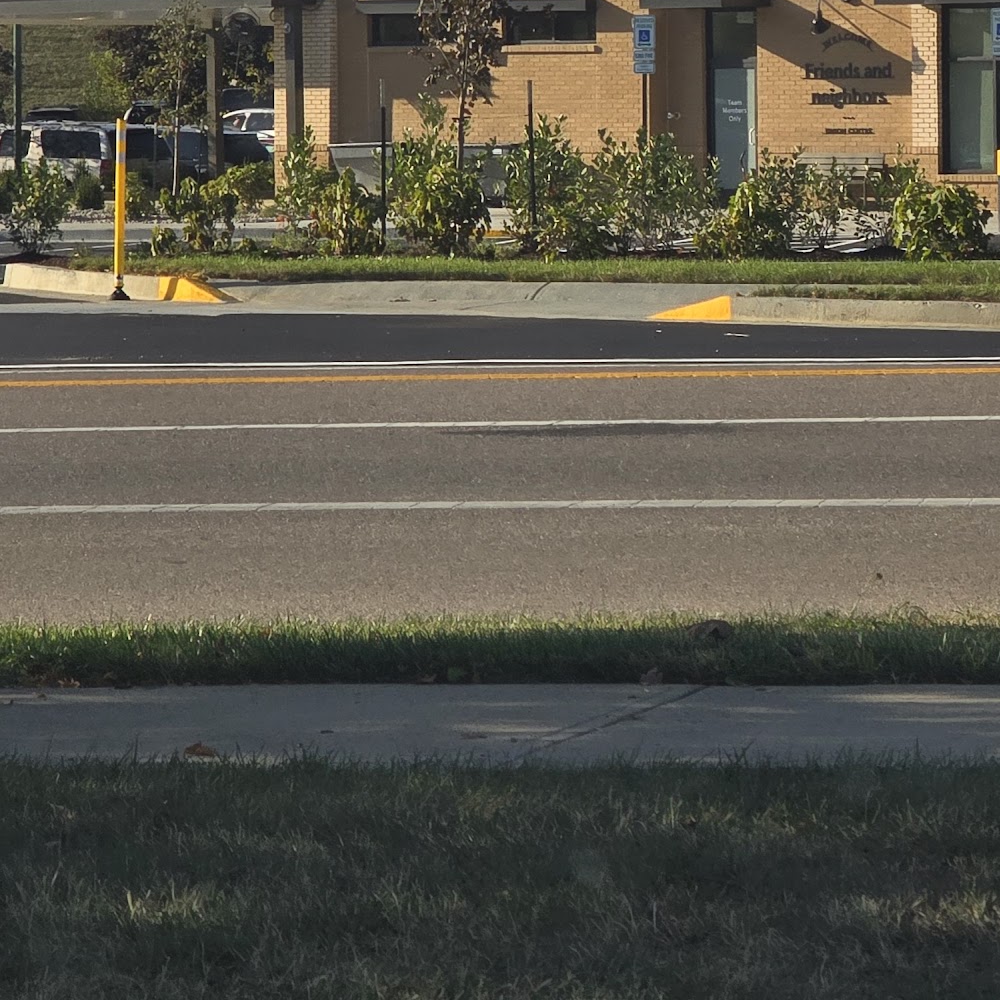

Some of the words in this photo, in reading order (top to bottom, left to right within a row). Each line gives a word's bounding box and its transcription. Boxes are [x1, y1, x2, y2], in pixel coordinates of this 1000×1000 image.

[805, 62, 861, 79] Friends
[863, 61, 893, 79] and
[812, 87, 889, 109] neighbors
